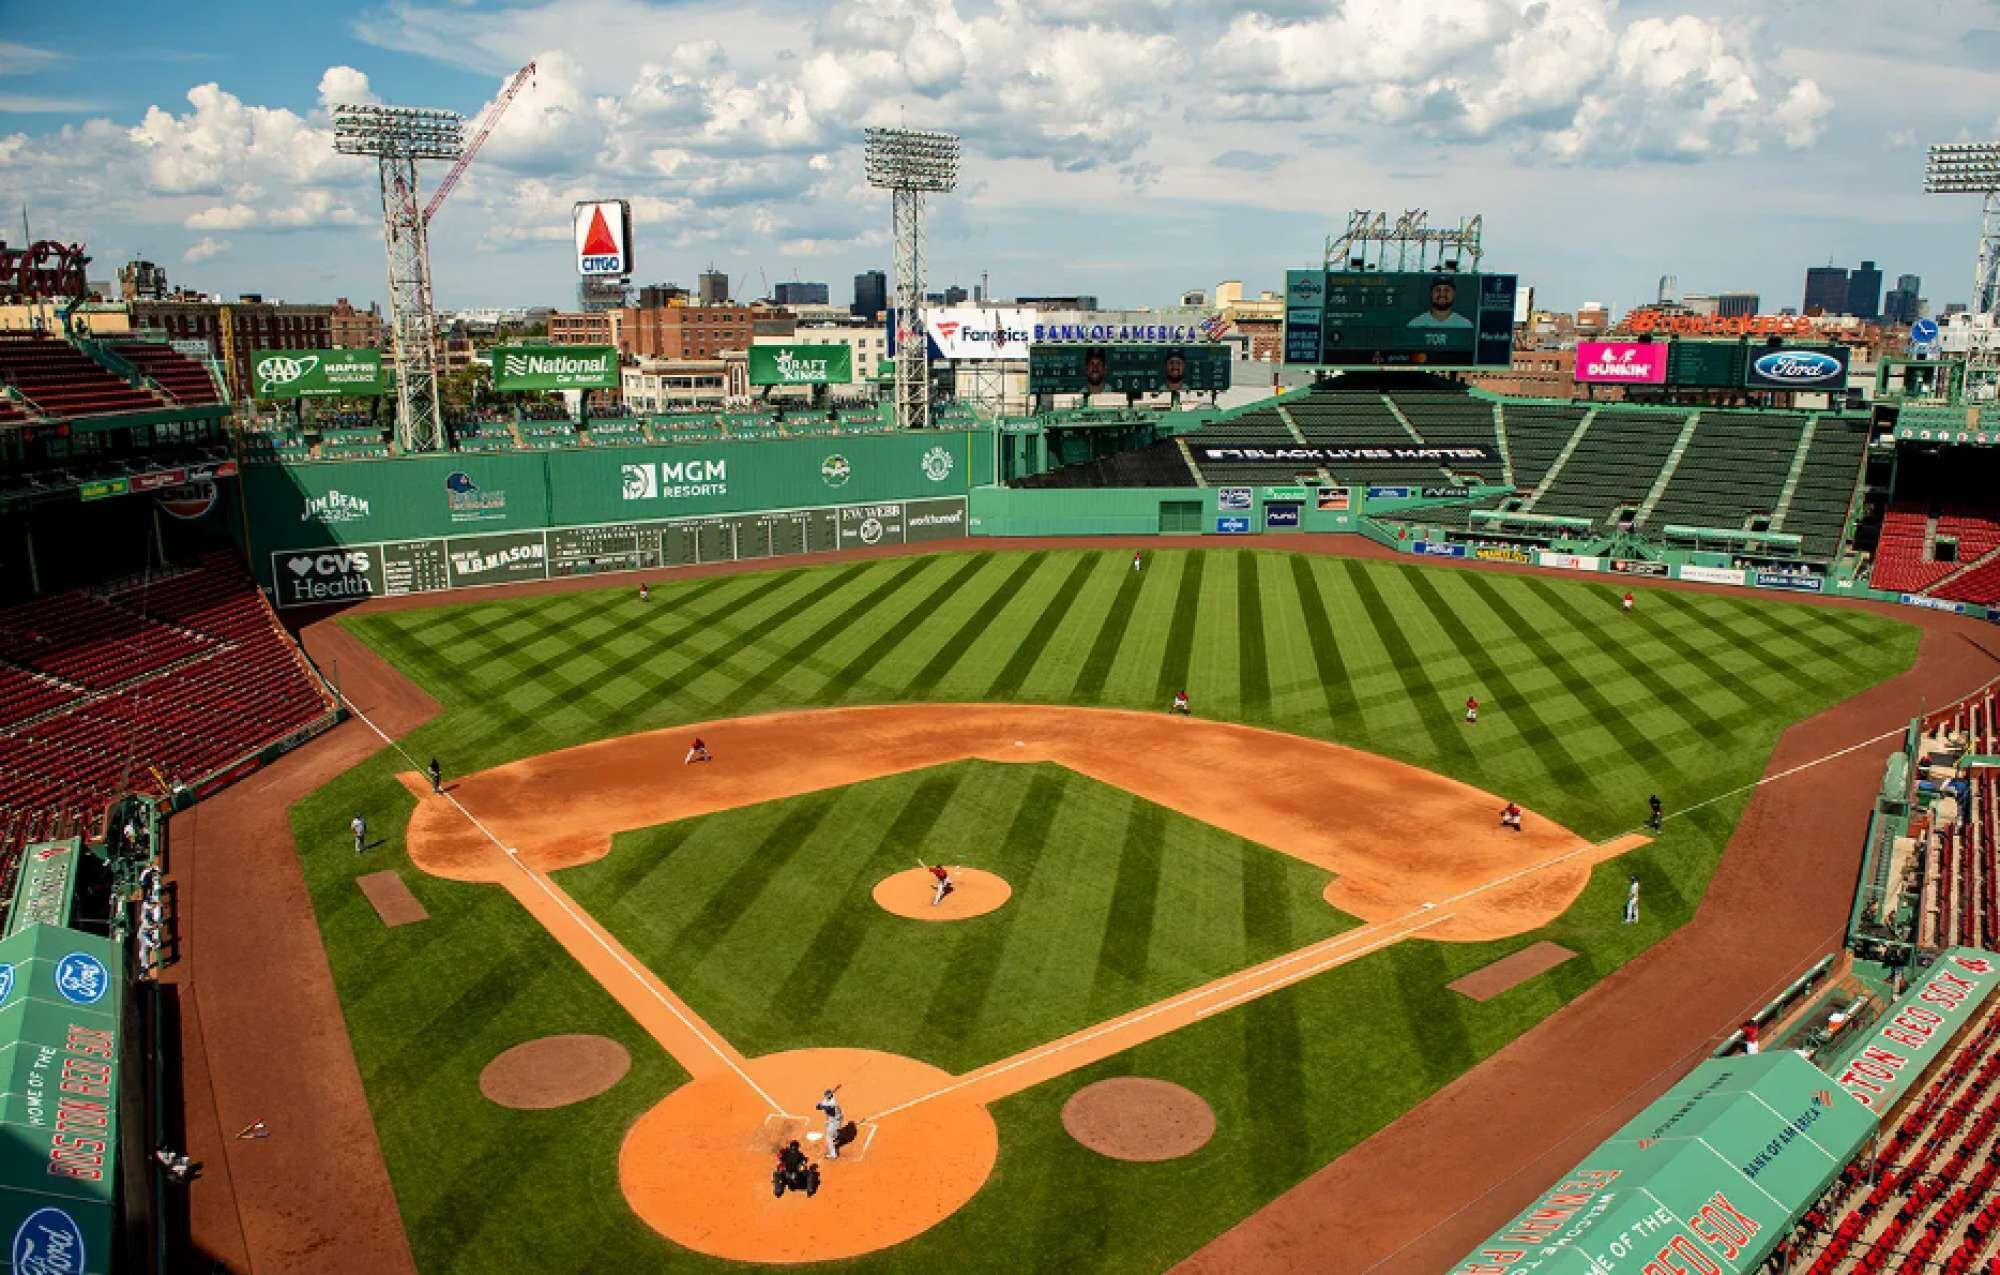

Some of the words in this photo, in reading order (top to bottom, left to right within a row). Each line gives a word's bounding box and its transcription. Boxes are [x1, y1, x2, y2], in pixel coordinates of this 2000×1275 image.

[582, 256, 619, 270] CITGO
[1034, 325, 1087, 340] BANK
[1091, 325, 1114, 340] OF
[1119, 325, 1196, 340] AMERICA
[781, 359, 828, 371] DRAFT
[1771, 354, 1823, 377] Ford
[661, 459, 727, 483] MGM
[663, 483, 727, 498] RESORTS
[301, 496, 328, 521] JIM
[329, 490, 369, 515] BEAM
[316, 552, 369, 575] CVS
[293, 573, 373, 599] Health
[1882, 1004, 1945, 1050] RED
[1919, 969, 1980, 1011] SOX
[66, 1023, 114, 1060] SOX
[34, 1046, 57, 1068] THE
[30, 1070, 44, 1088] OF
[60, 1057, 111, 1098] RED
[27, 1089, 46, 1126] HOME
[47, 1096, 110, 1180] BOSTON
[1741, 1150, 1772, 1180] BANK
[1778, 1106, 1821, 1145] AMERICA
[1499, 1169, 1625, 1245] FENWAY
[1609, 1231, 1633, 1258] OF
[1631, 1206, 1674, 1238] THE
[1688, 1190, 1764, 1261] SOX
